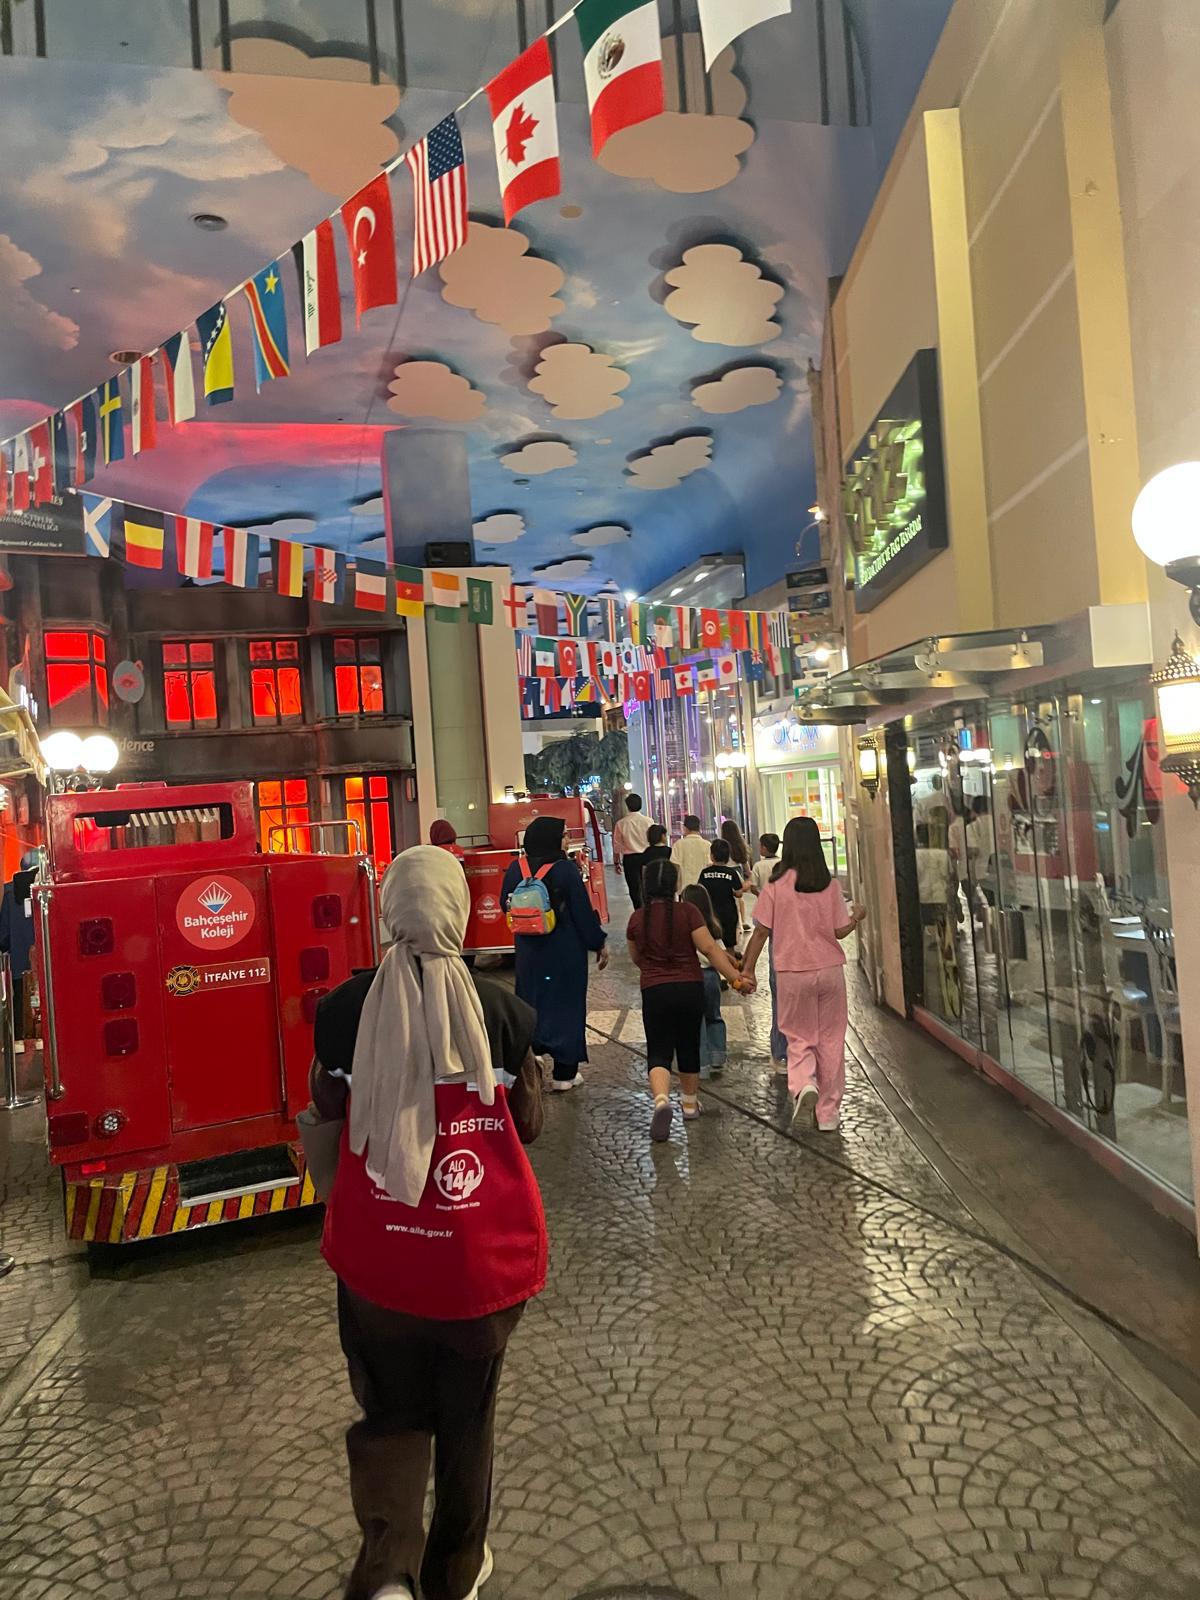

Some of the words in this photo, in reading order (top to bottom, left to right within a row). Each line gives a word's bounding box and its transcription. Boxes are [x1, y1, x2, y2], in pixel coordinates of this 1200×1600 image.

[119, 737, 155, 752] dence
[184, 911, 248, 927] Bahçeşehir
[201, 925, 234, 939] Koleji
[204, 969, 246, 983] İTFAİYE
[248, 967, 267, 978] 112
[450, 1117, 505, 1135] DESTEK
[448, 1159, 467, 1173] ALO
[443, 1169, 475, 1191] 144
[385, 1223, 453, 1238] www.aile.gov.tr
